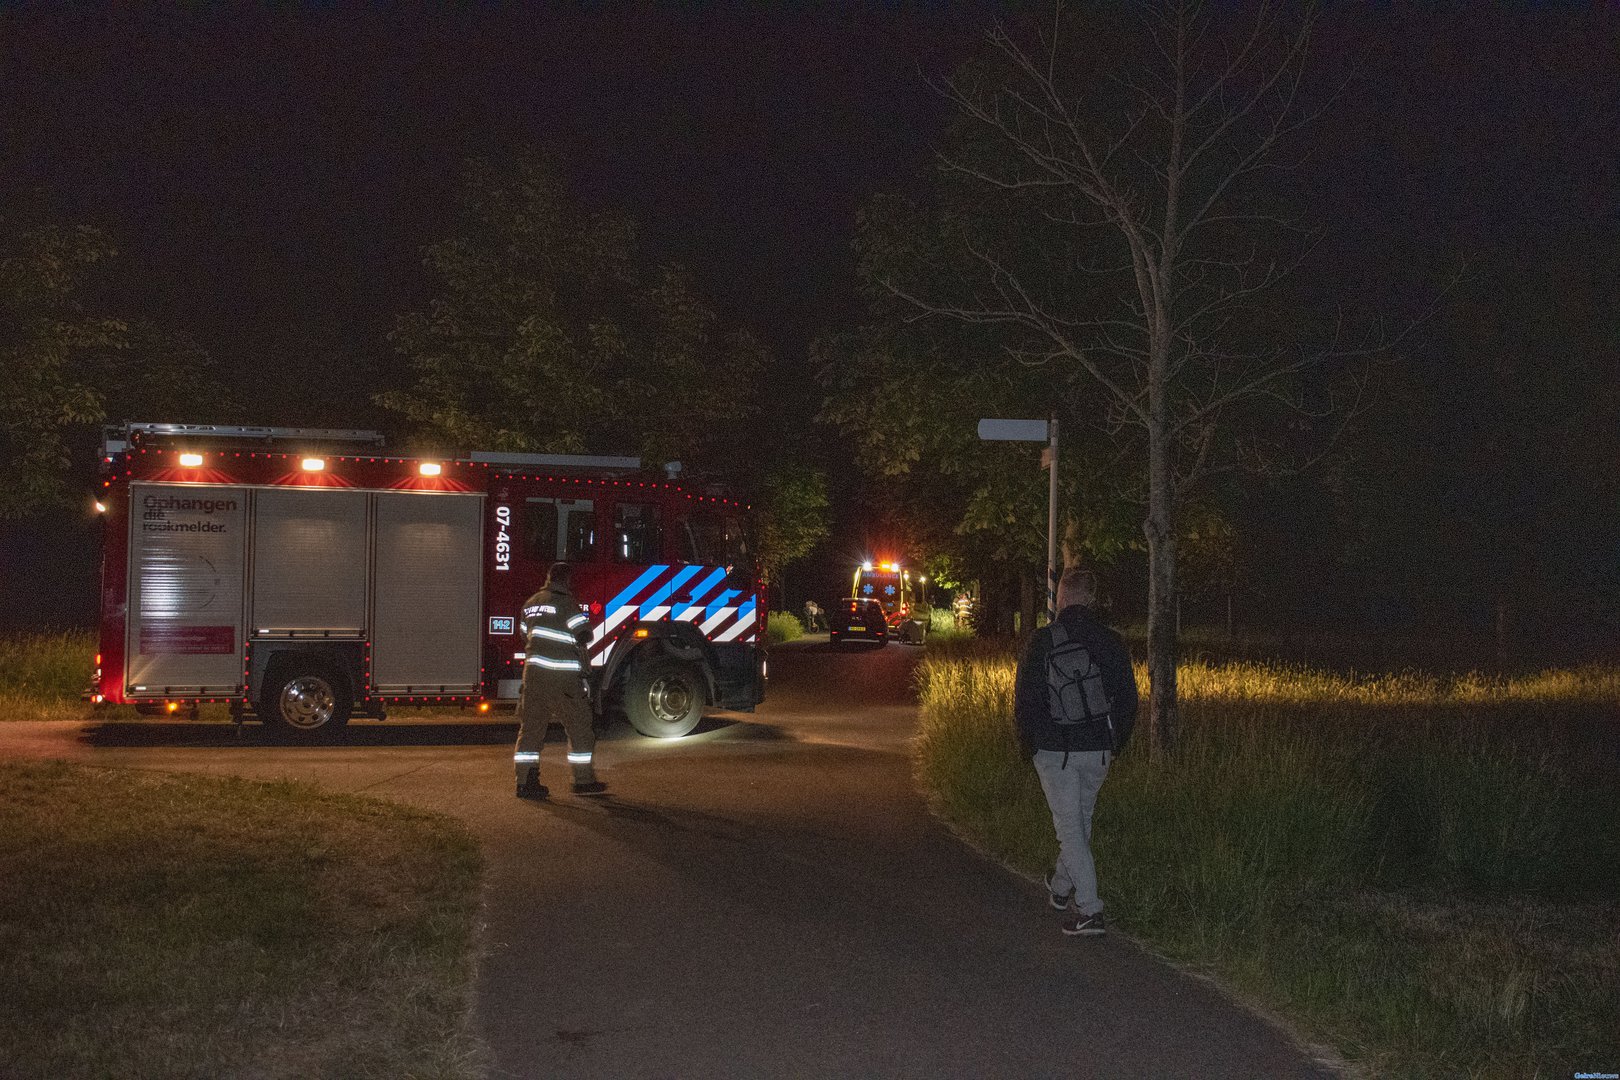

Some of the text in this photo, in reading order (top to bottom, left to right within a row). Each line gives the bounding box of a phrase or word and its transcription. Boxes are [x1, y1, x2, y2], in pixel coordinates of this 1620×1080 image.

[143, 496, 237, 514] Ophangen
[143, 508, 165, 520] die
[143, 521, 226, 532] rookmelder.
[496, 506, 510, 570] 07-4631
